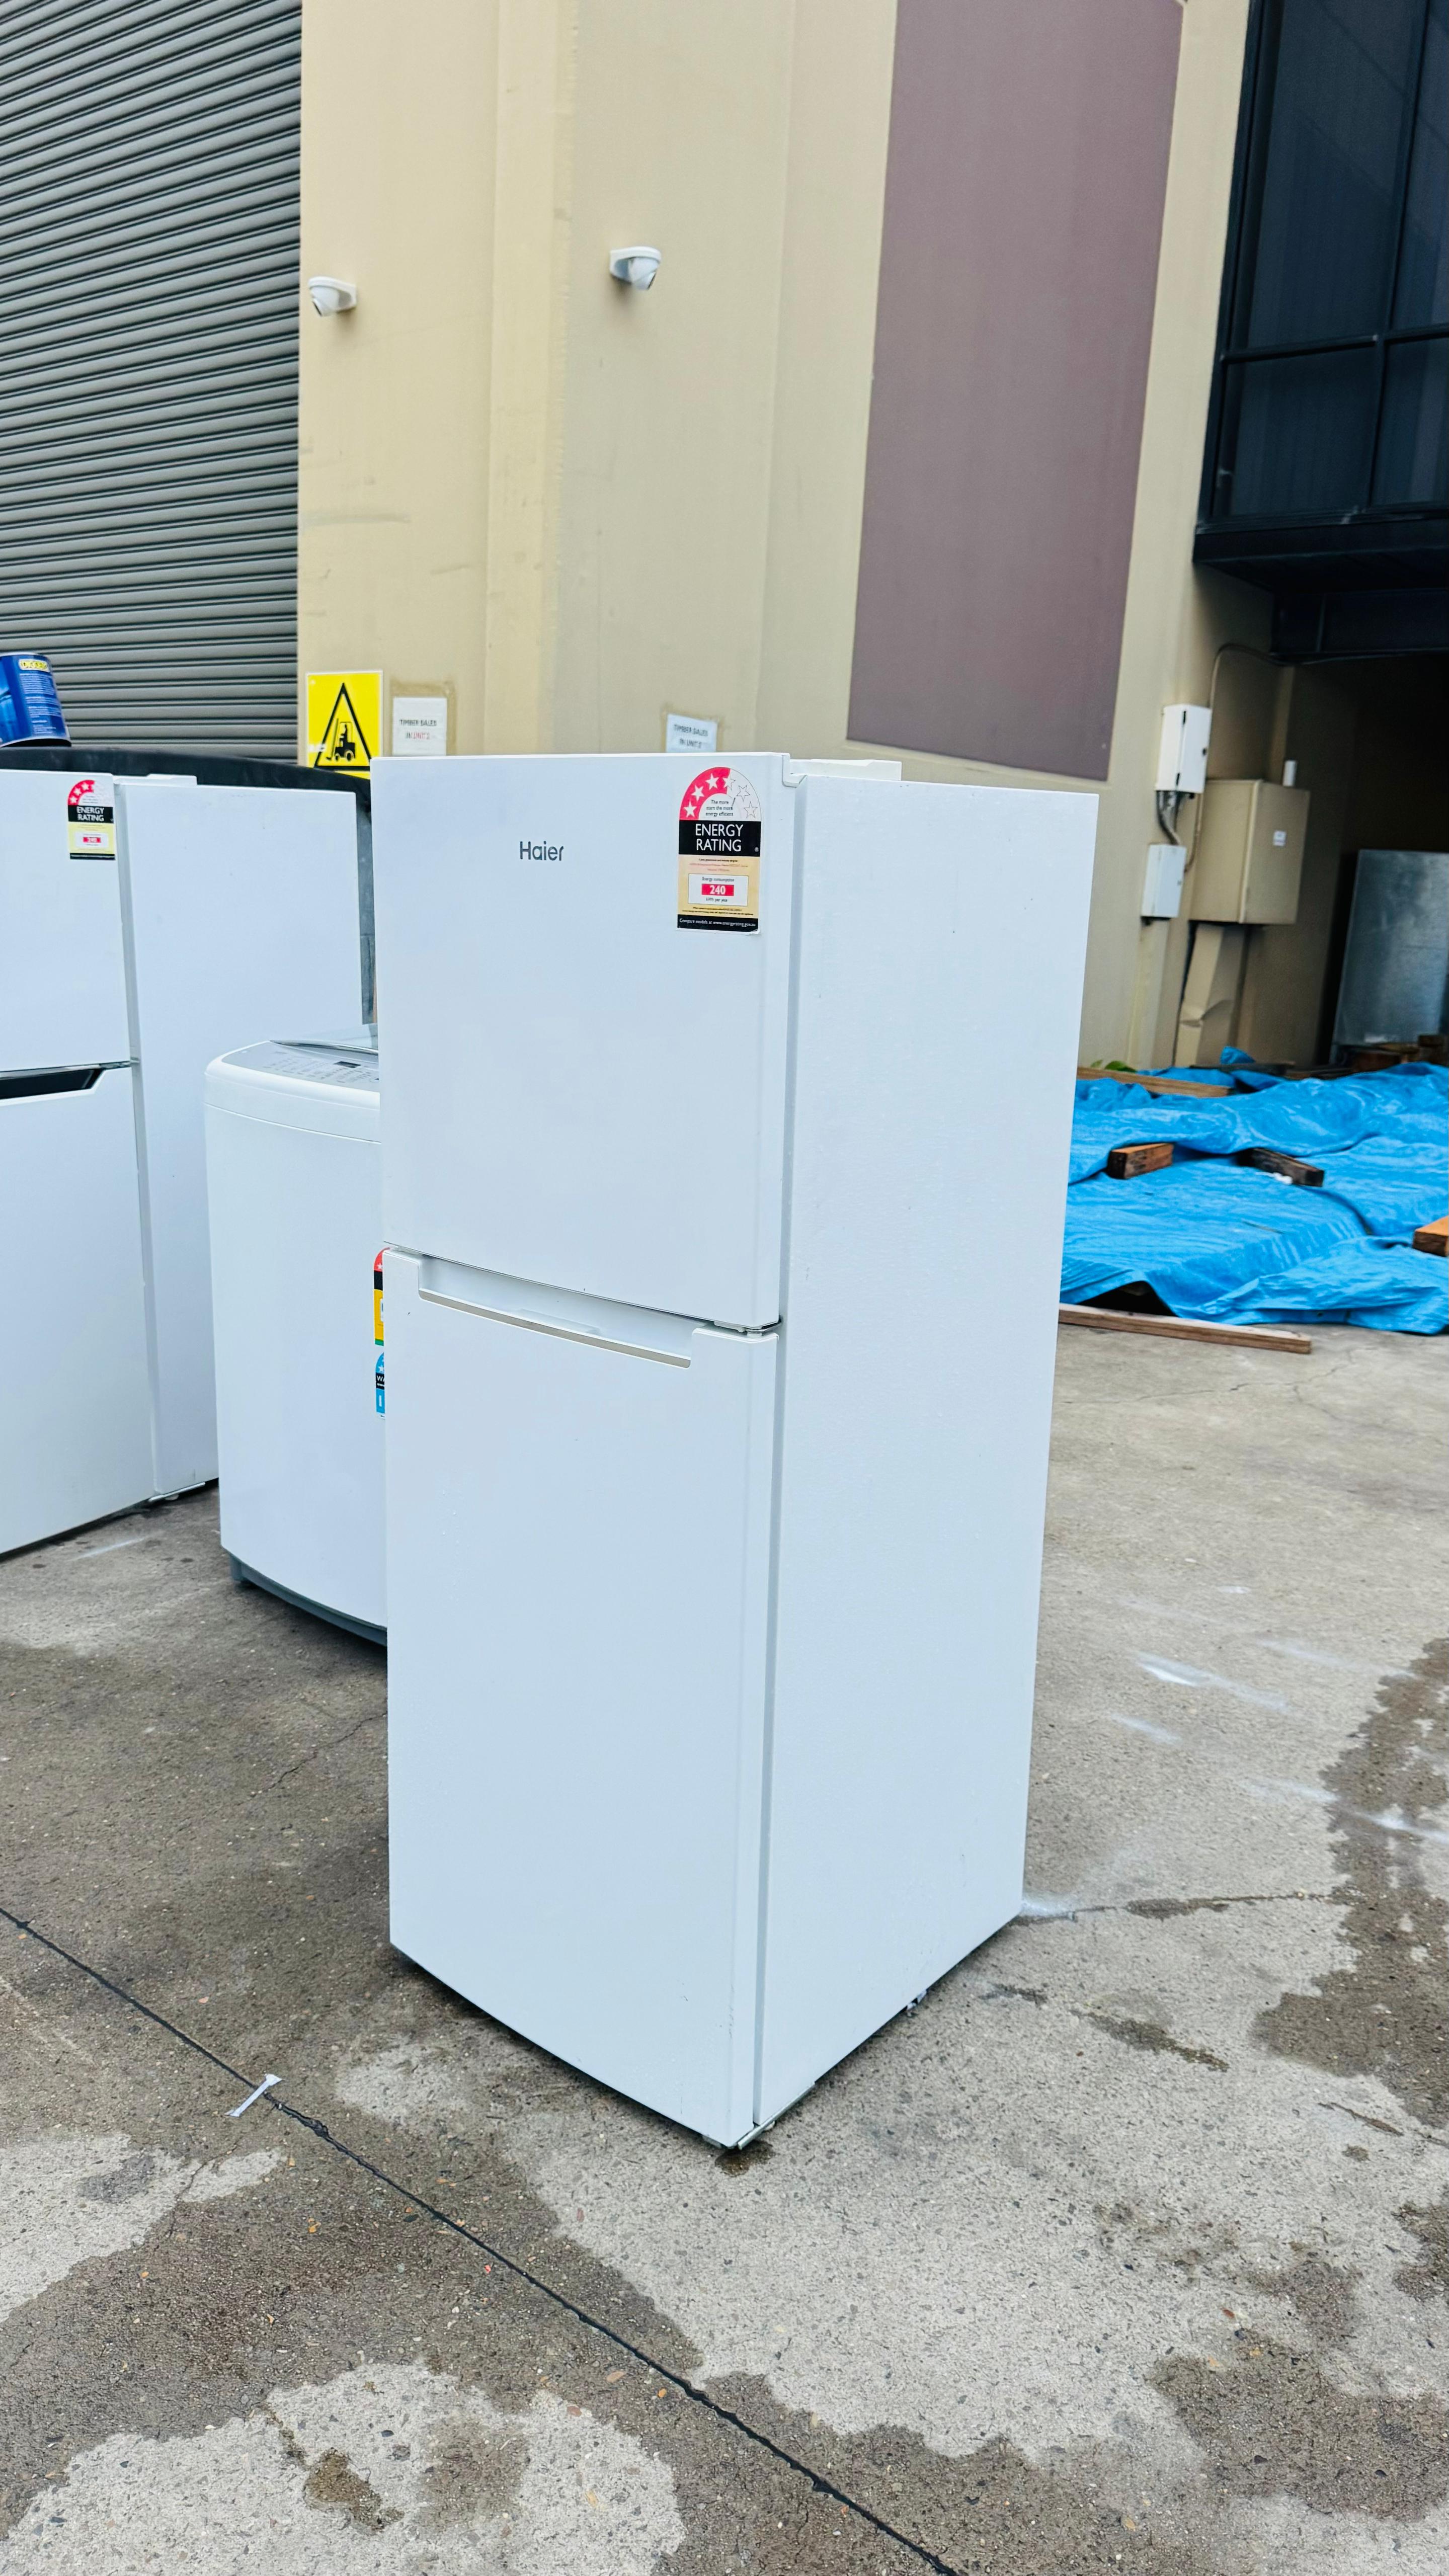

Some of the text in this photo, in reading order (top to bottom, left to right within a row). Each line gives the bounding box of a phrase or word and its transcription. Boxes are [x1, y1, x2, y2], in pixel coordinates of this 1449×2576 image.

[695, 824, 743, 837] ENERGY
[520, 841, 564, 861] Haier
[696, 838, 742, 851] RATING
[709, 885, 726, 895] 240
